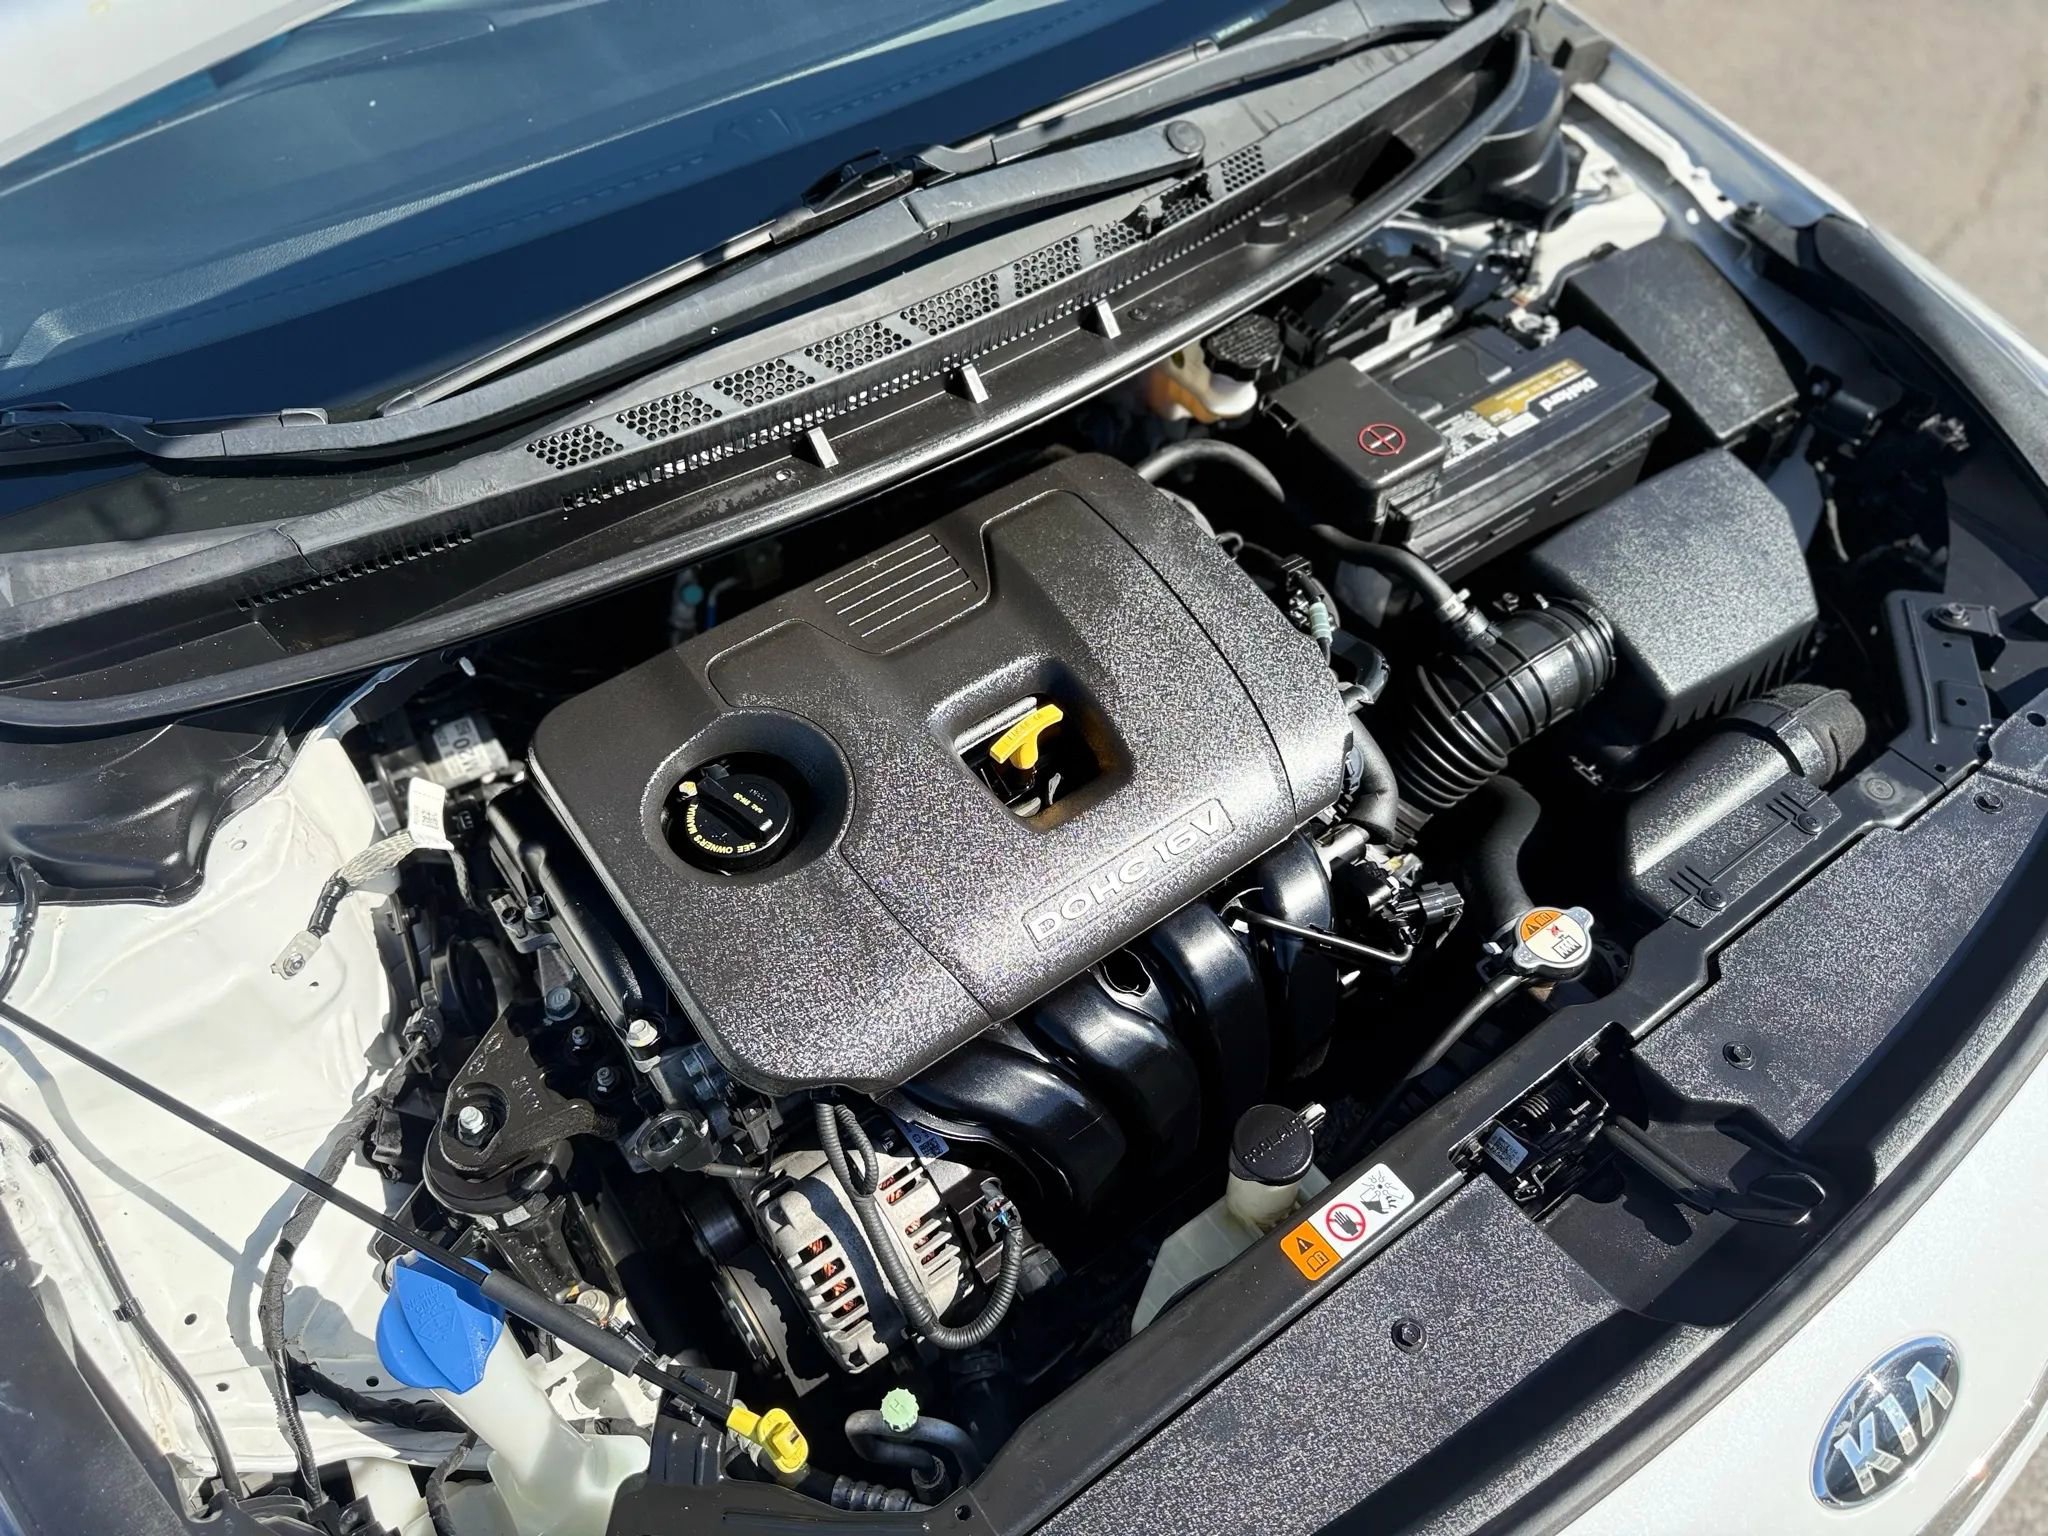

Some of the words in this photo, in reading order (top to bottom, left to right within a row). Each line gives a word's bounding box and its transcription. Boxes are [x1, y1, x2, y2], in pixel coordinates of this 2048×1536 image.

[1538, 376, 1599, 413] DieHard
[686, 803, 699, 835] MANUAL
[693, 834, 734, 855] OWNER'S
[736, 842, 757, 854] SEE
[1026, 855, 1153, 944] DOHC
[1152, 806, 1222, 864] 16V
[1833, 1360, 1953, 1495] KIA
